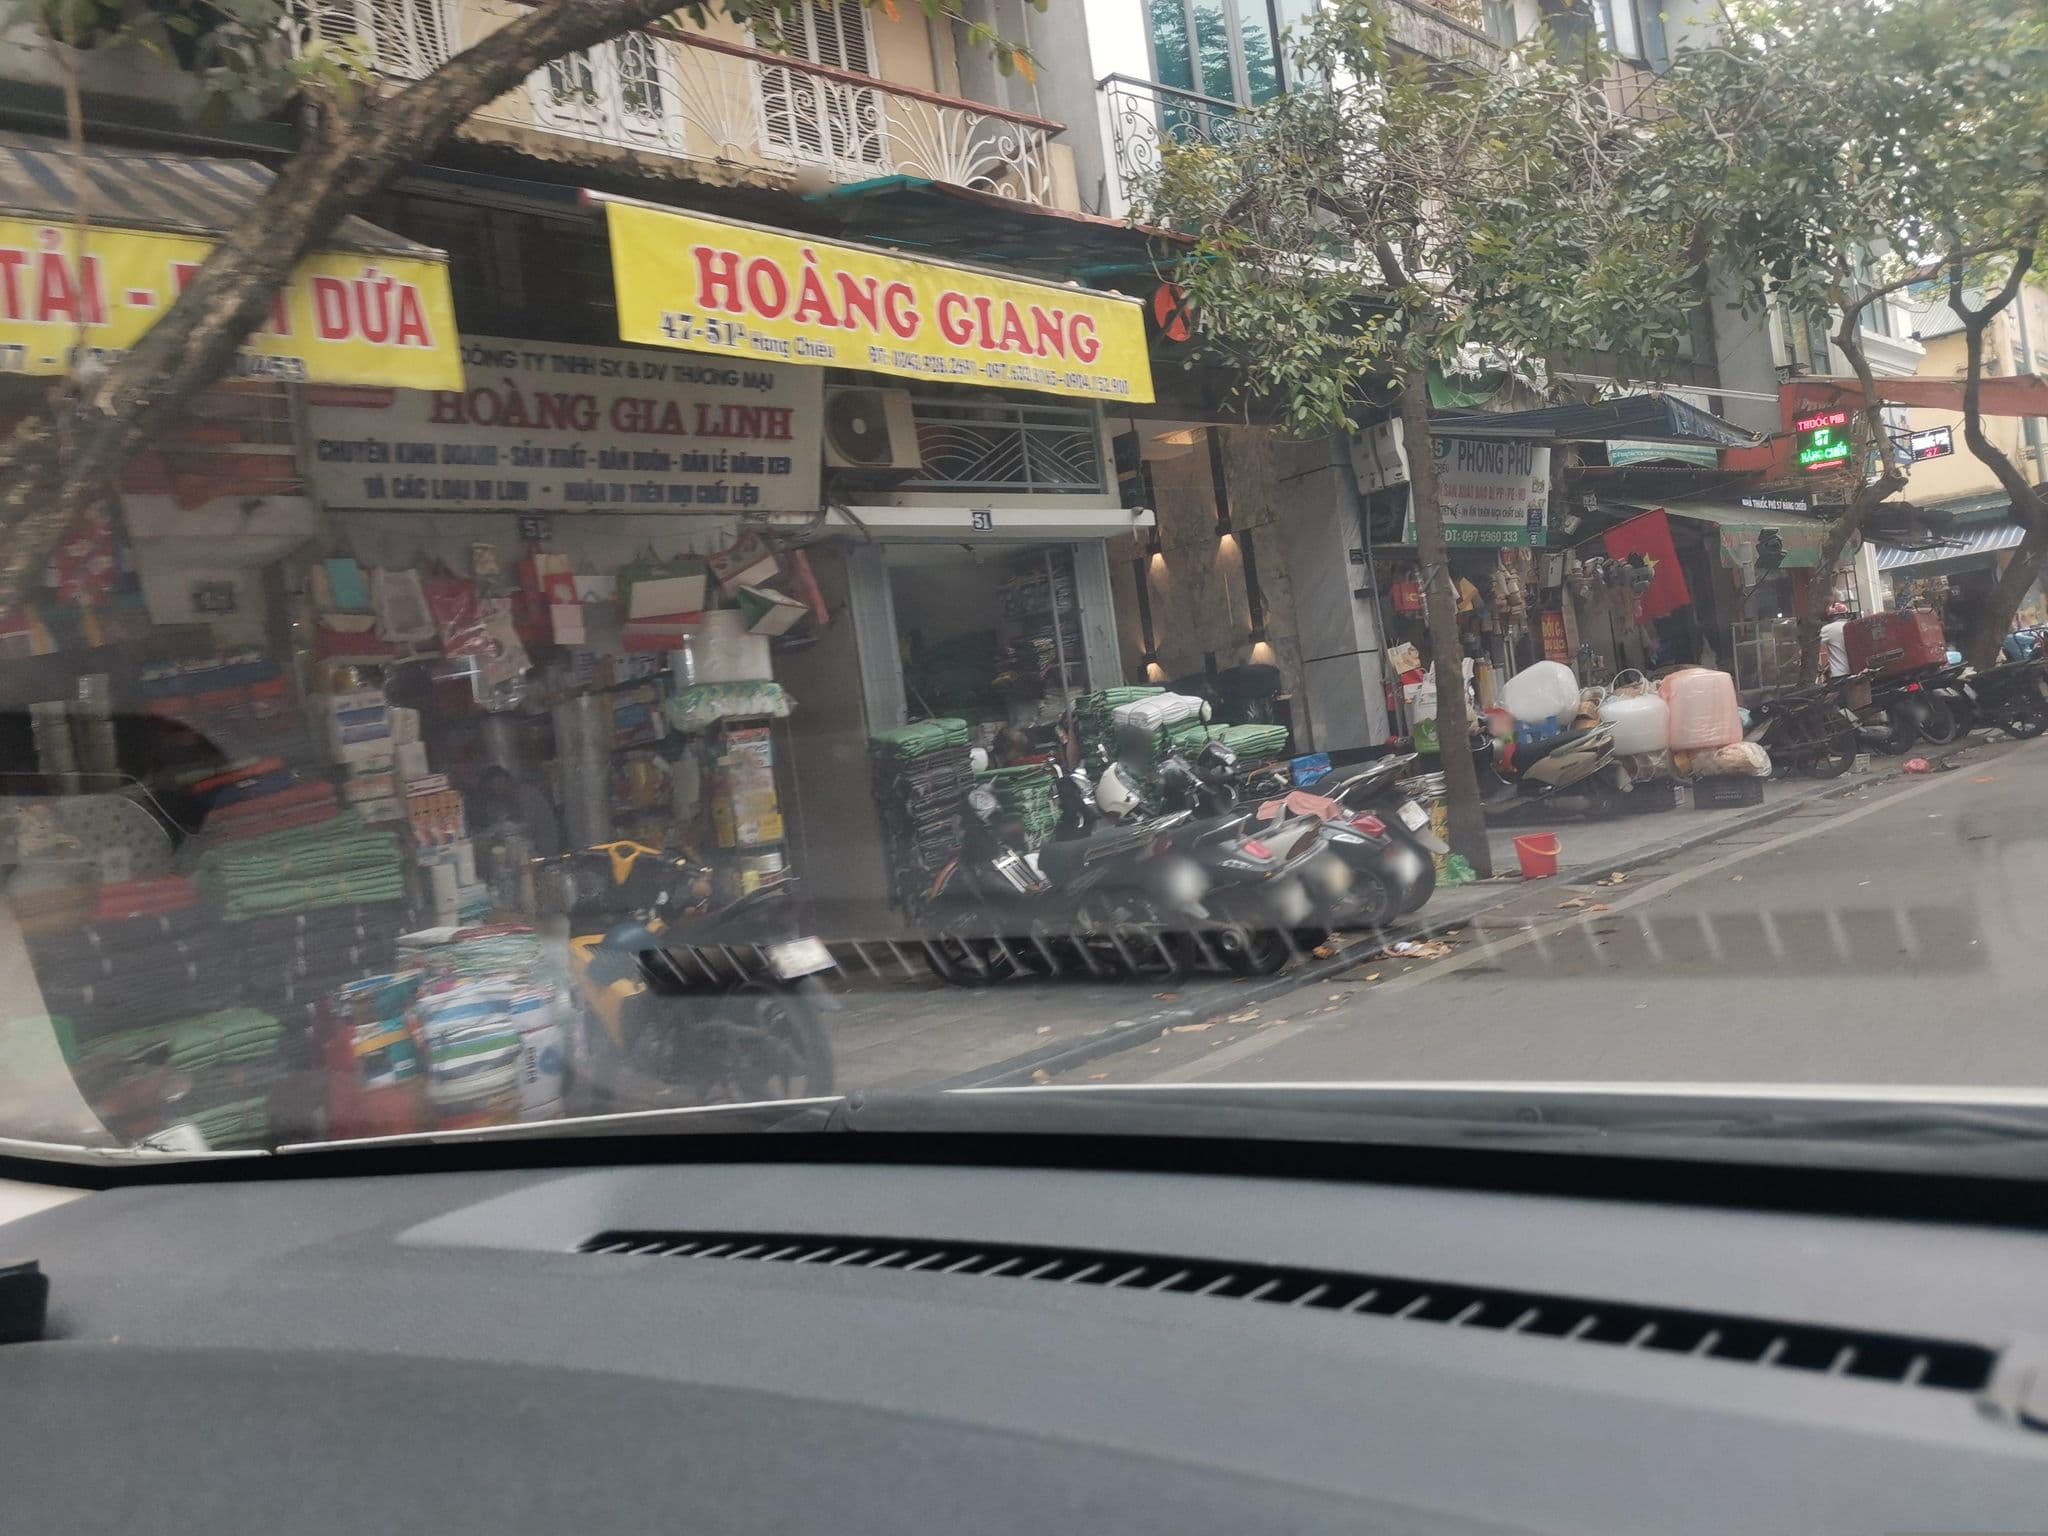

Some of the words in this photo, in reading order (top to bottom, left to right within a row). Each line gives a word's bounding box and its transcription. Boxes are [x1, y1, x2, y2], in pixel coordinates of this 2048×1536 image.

[313, 268, 433, 347] DỨA
[693, 247, 919, 340] HOÀNG
[937, 291, 1103, 364] GIANG
[431, 376, 601, 432] HOÀNG
[609, 396, 688, 435] GIA
[692, 401, 795, 440] LINH
[1457, 440, 1504, 474] PHONG
[974, 513, 990, 530] 51
